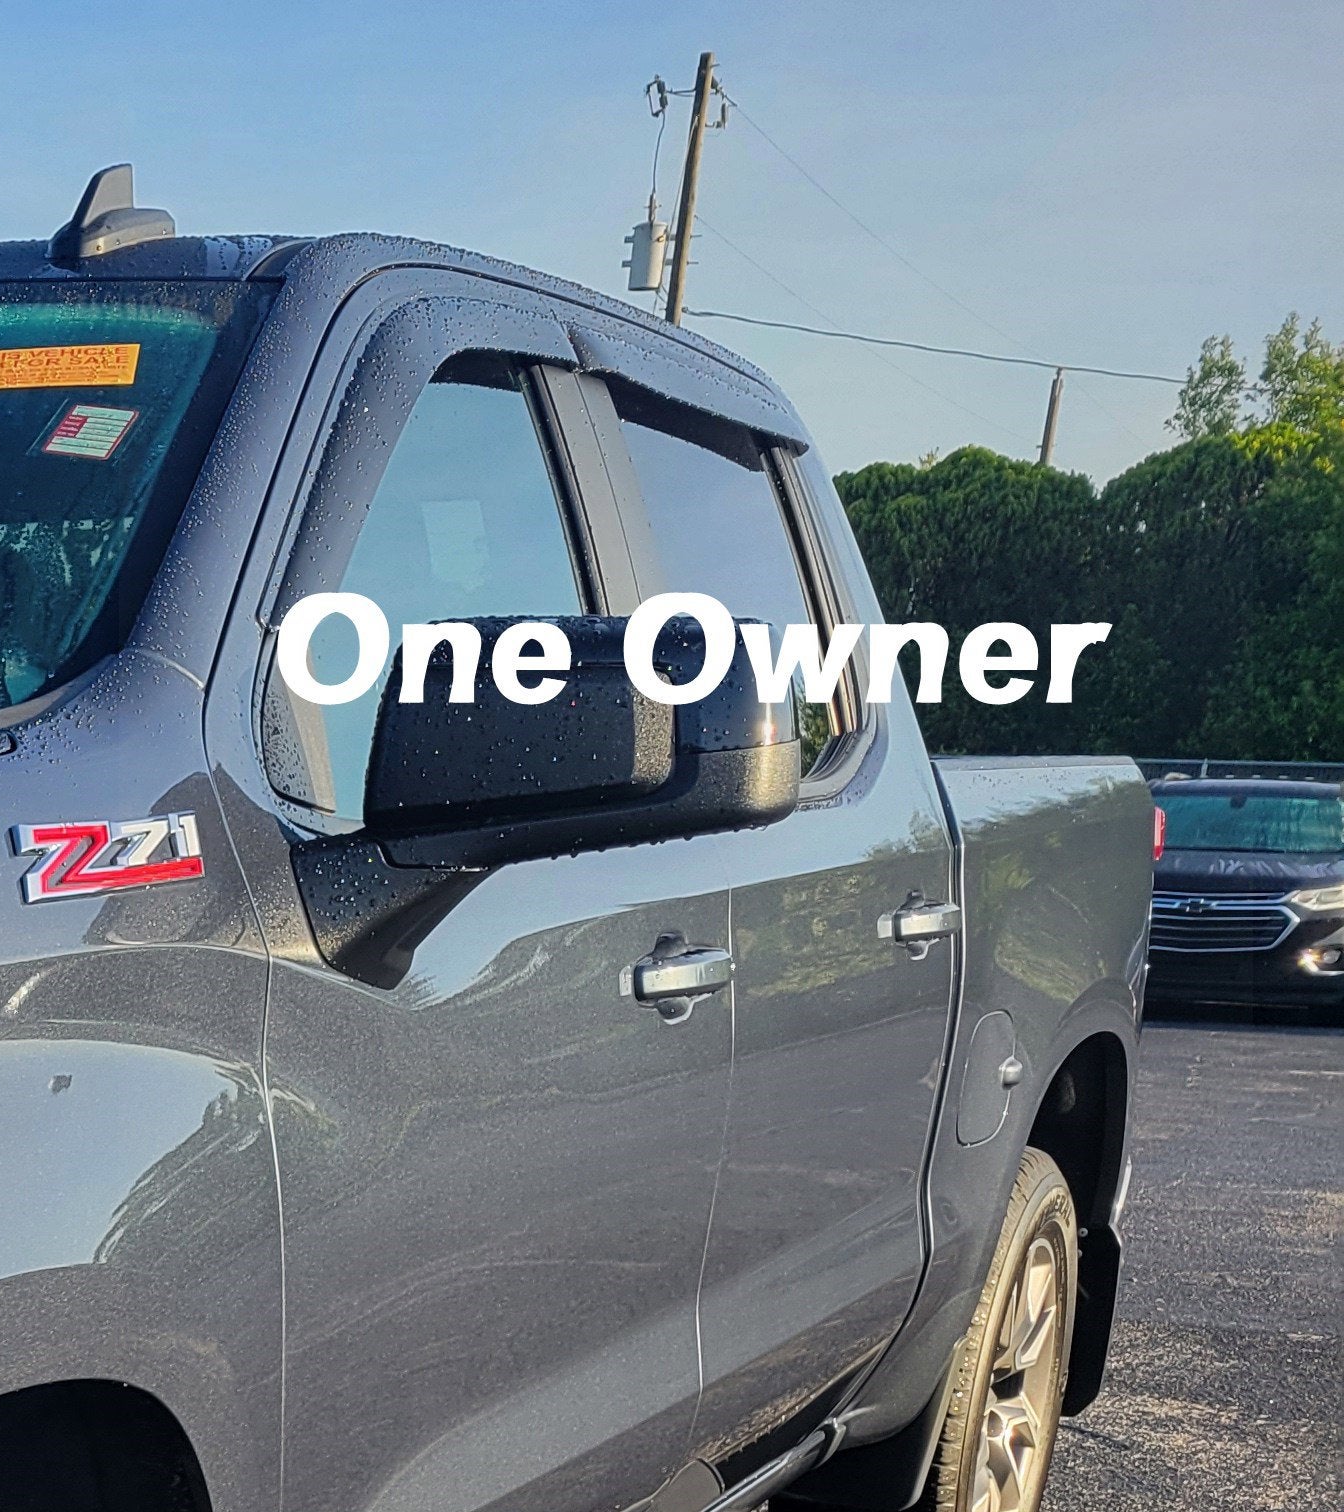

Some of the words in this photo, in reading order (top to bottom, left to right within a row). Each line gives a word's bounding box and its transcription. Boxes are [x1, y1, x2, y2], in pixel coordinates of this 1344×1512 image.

[28, 346, 129, 358] VEHICLE
[12, 358, 62, 367] FOR
[69, 354, 130, 366] SALE
[6, 810, 205, 904] Z71
